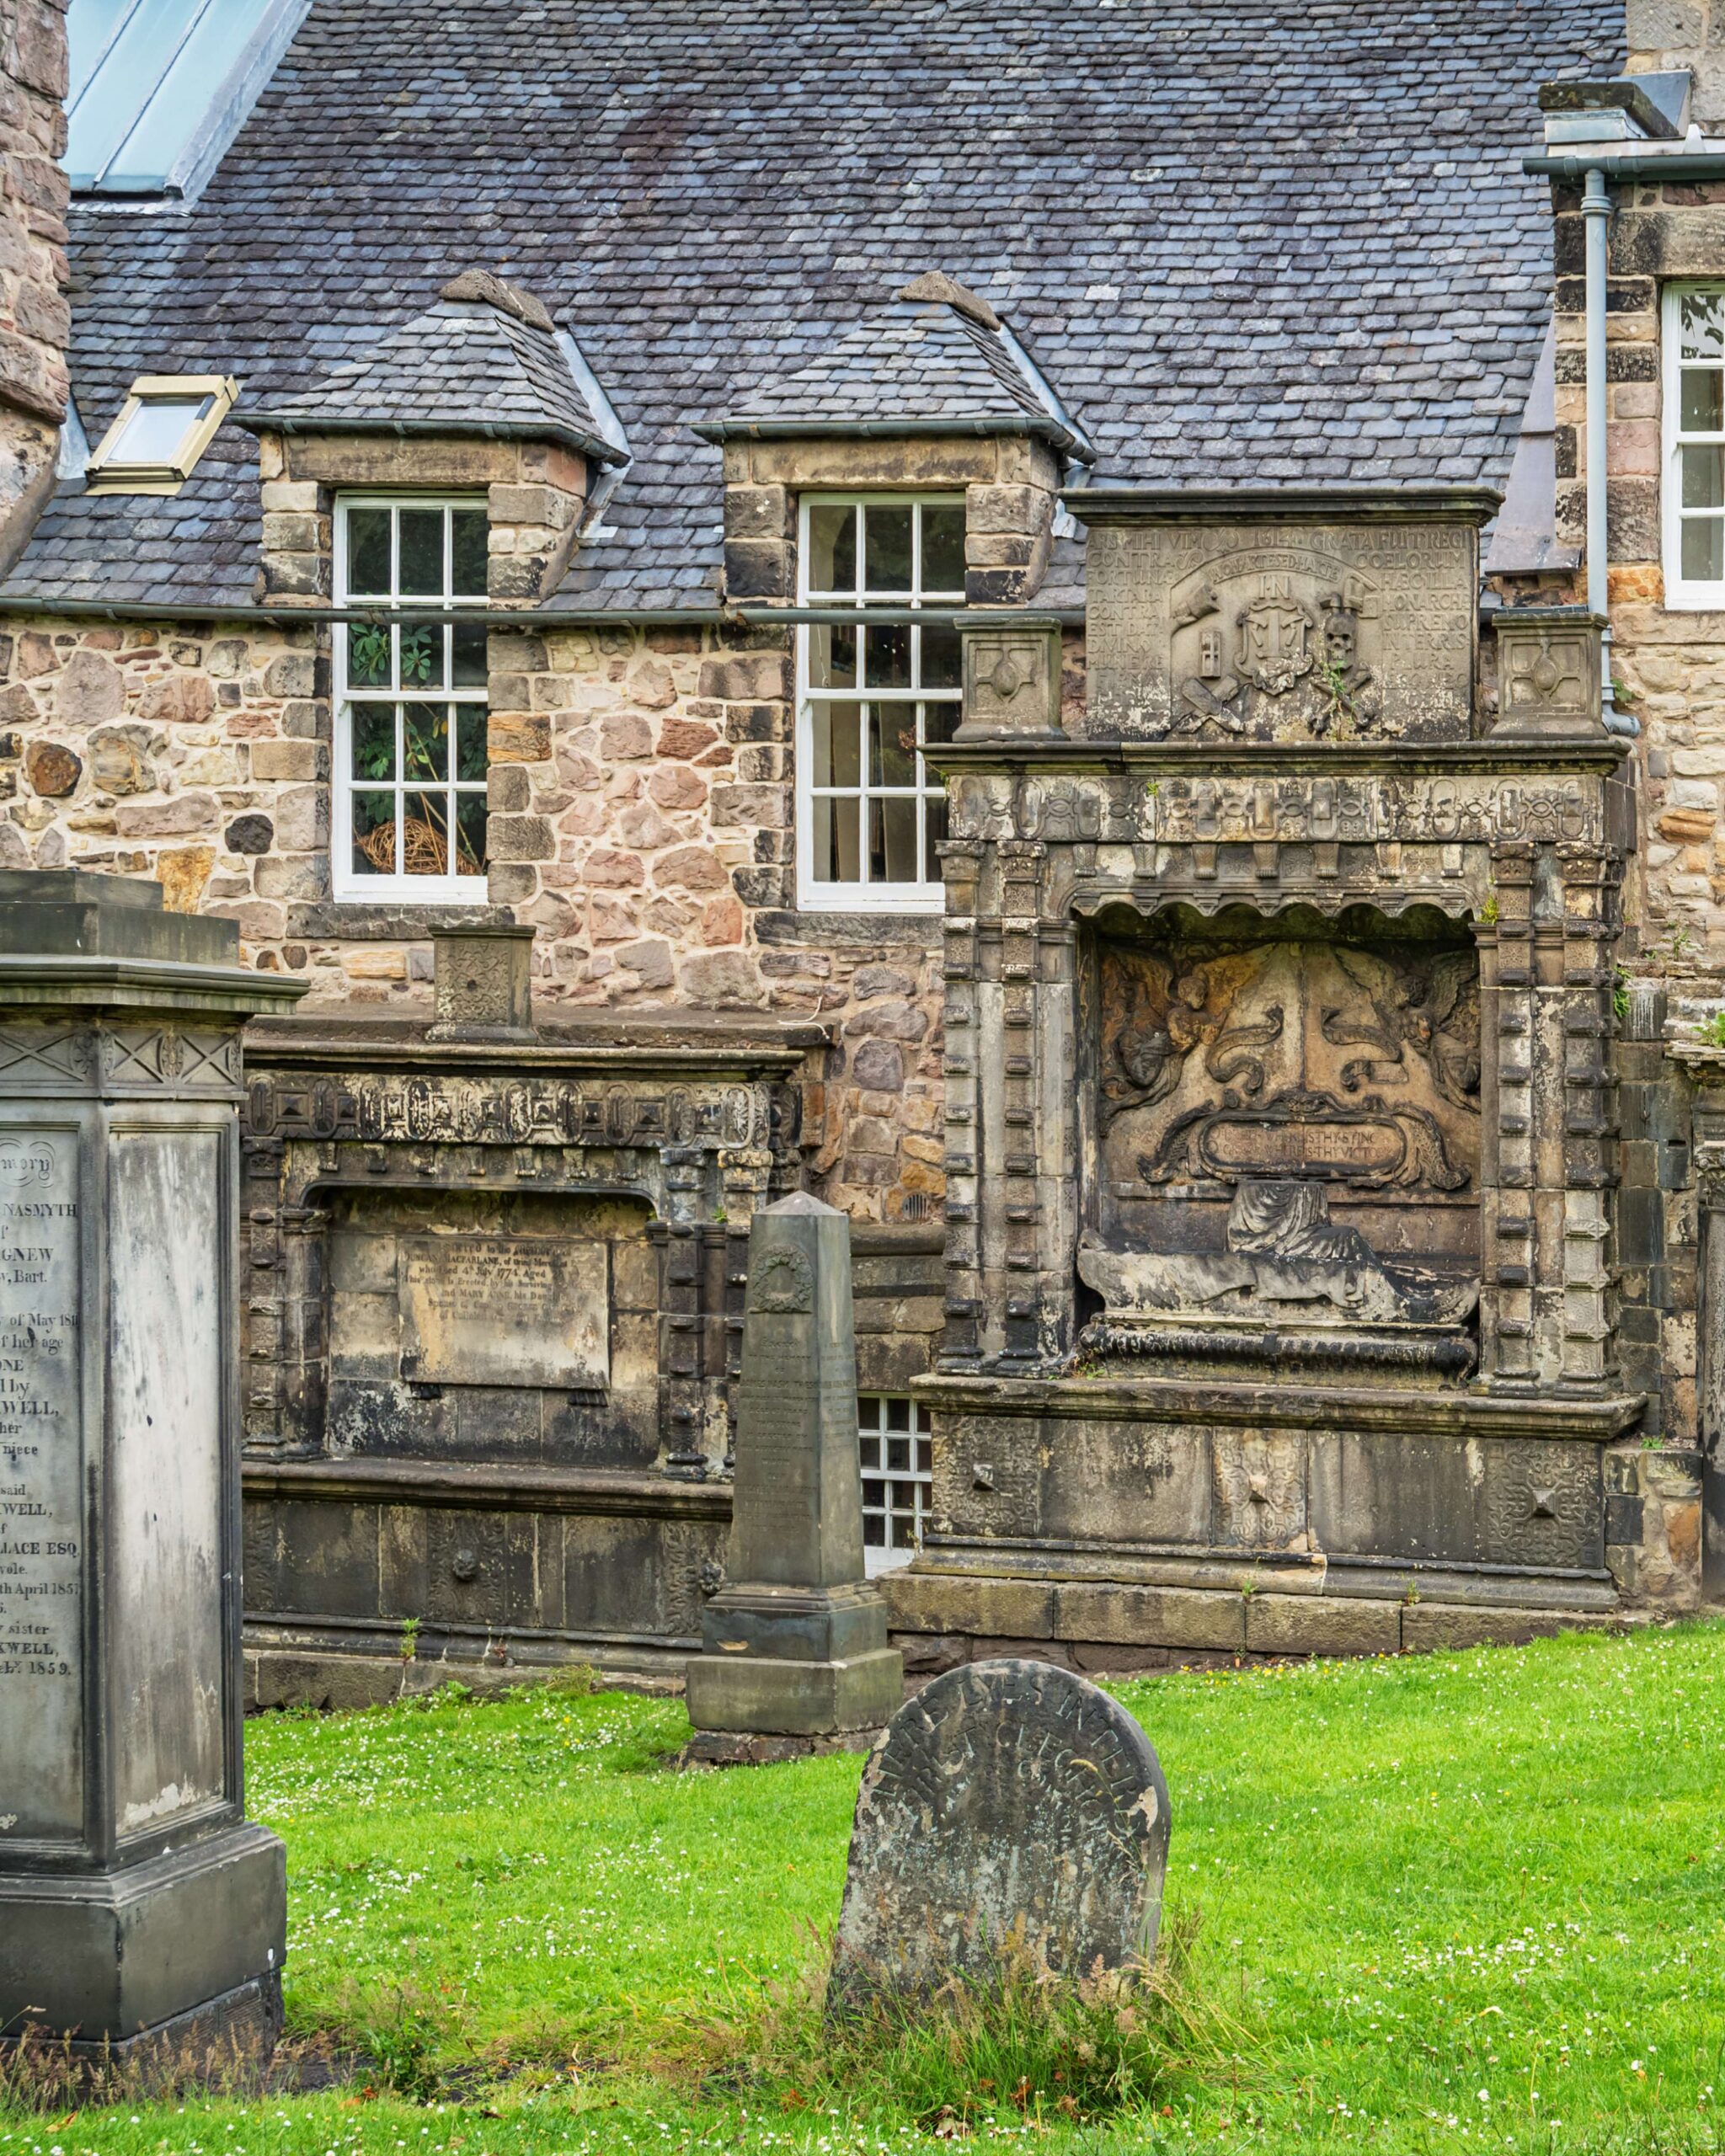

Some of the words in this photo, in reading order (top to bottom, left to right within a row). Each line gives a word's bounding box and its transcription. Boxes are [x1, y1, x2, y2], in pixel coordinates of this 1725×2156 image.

[1310, 531, 1374, 550] GRATA
[1088, 551, 1175, 568] CONTRA
[3, 1203, 77, 1218] NASMYTH
[0, 1248, 54, 1262] GNEW
[13, 1269, 47, 1283] Bart.
[10, 1314, 25, 1326] of
[28, 1313, 56, 1334] May
[41, 1337, 64, 1355] age
[10, 1379, 30, 1400] by
[0, 1401, 60, 1417] WELL,
[3, 1442, 39, 1455] niece
[1, 1484, 26, 1496] said
[0, 1503, 53, 1518] WELL,
[0, 1542, 40, 1555] LACE
[14, 1582, 48, 1601] April
[8, 1620, 50, 1636] sister
[29, 1662, 72, 1676] 1859.
